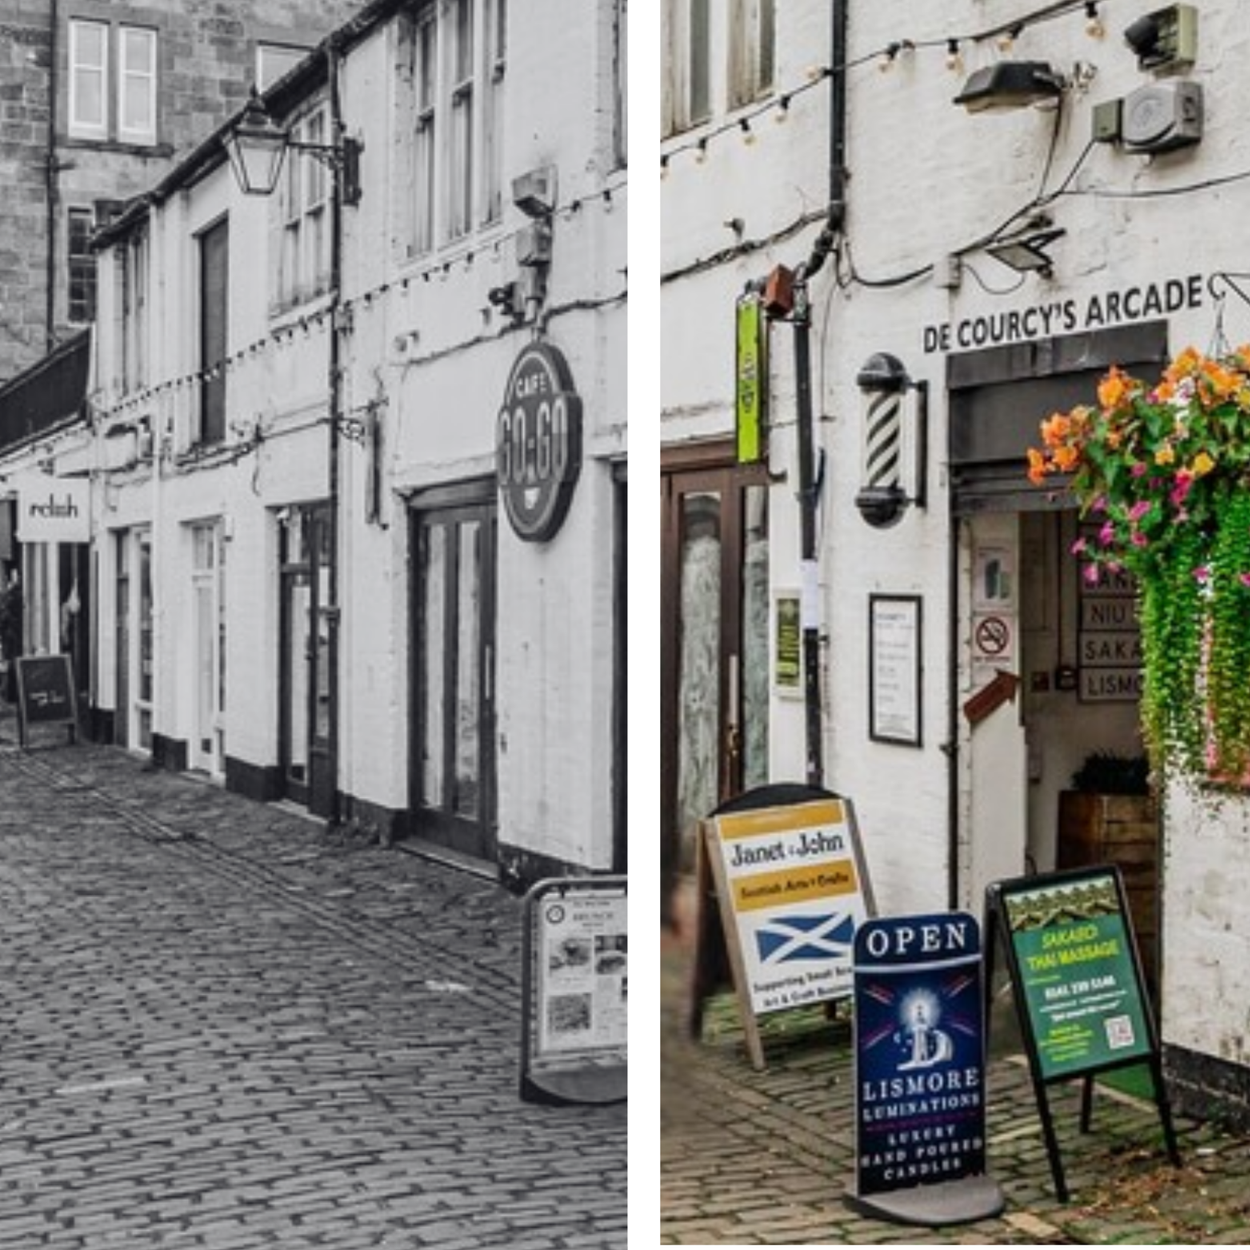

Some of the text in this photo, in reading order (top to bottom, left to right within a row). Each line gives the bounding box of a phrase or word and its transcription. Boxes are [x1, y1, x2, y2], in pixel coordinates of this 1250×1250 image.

[924, 275, 1203, 353] DE COURCY'S ARCADE
[732, 841, 786, 867] Janet
[796, 832, 843, 857] John
[867, 923, 967, 957] OPEN
[1027, 939, 1119, 970] THAI MASSAGE
[863, 1069, 980, 1101] LISMORE
[863, 1093, 981, 1122] LUMINATIONS
[888, 1125, 956, 1146] LUXURY
[861, 1137, 983, 1168] HAND POURED
[884, 1158, 962, 1180] CANDLES
